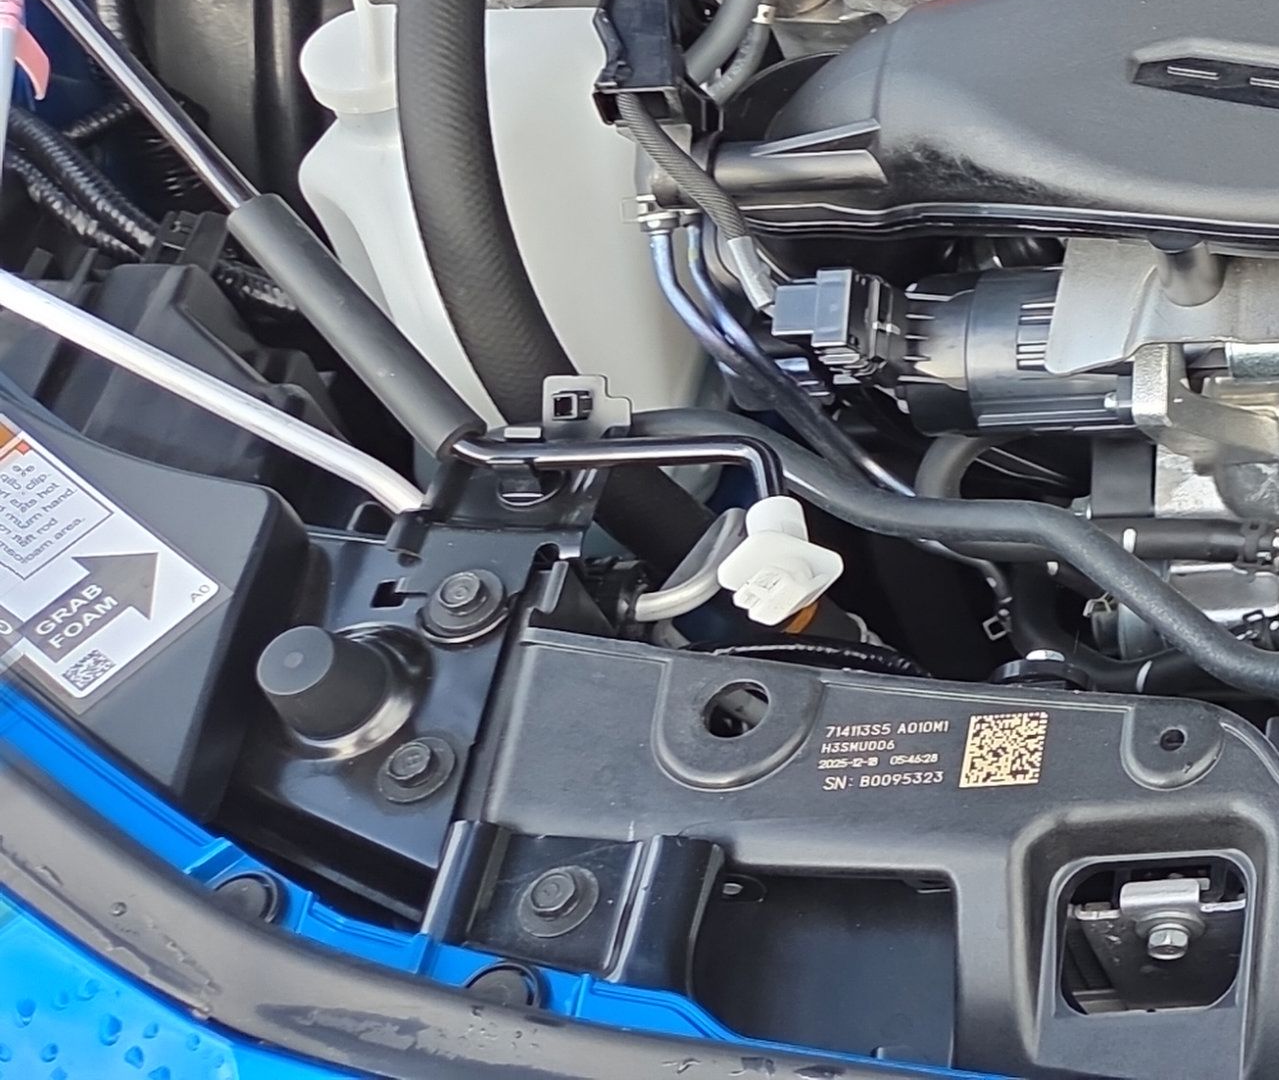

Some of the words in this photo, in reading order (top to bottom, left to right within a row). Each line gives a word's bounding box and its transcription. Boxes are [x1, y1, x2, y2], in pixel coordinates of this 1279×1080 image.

[35, 583, 103, 636] GRAB
[48, 595, 119, 650] FOAM
[825, 723, 892, 738] 714113S5
[822, 775, 854, 791] SN:
[858, 771, 944, 789] B0095323
